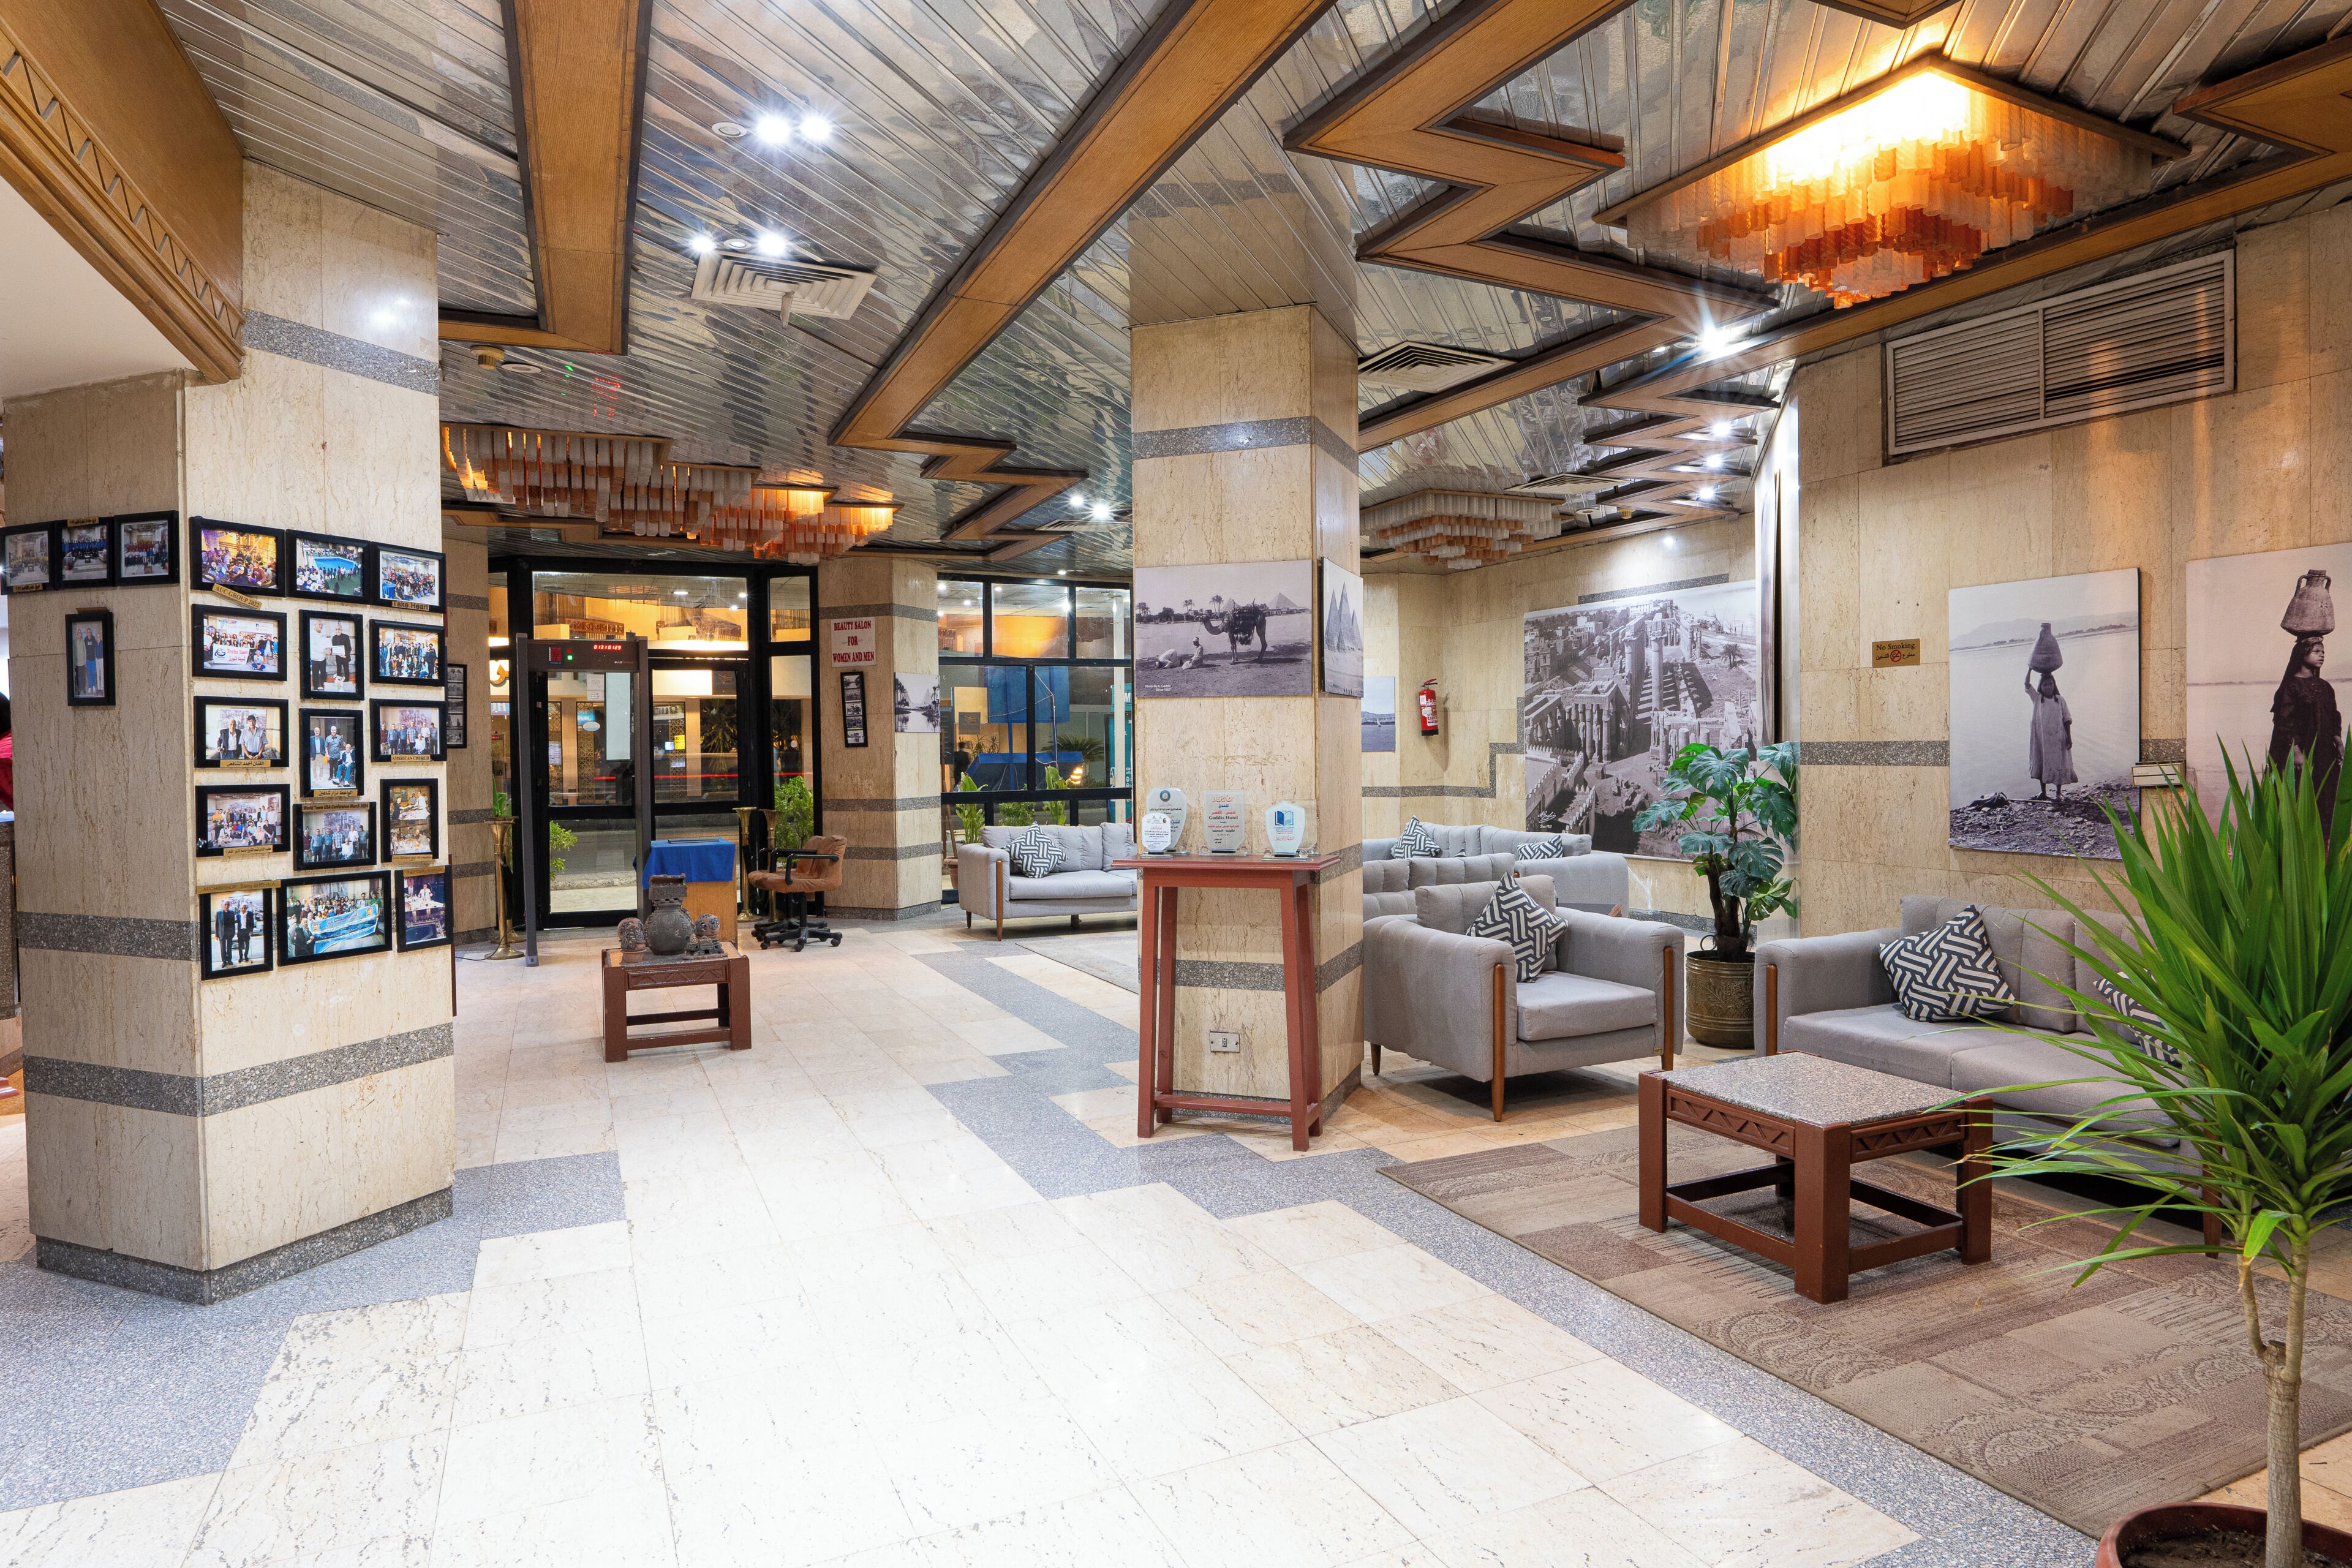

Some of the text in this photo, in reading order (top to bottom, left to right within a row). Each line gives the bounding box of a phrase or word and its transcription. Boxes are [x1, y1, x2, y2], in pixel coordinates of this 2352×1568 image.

[215, 586, 260, 608] AUC GROUP 2022
[834, 620, 872, 631] BEAUTY SALON
[848, 636, 858, 646] FOR
[832, 651, 875, 663] WOMEN AND MEN
